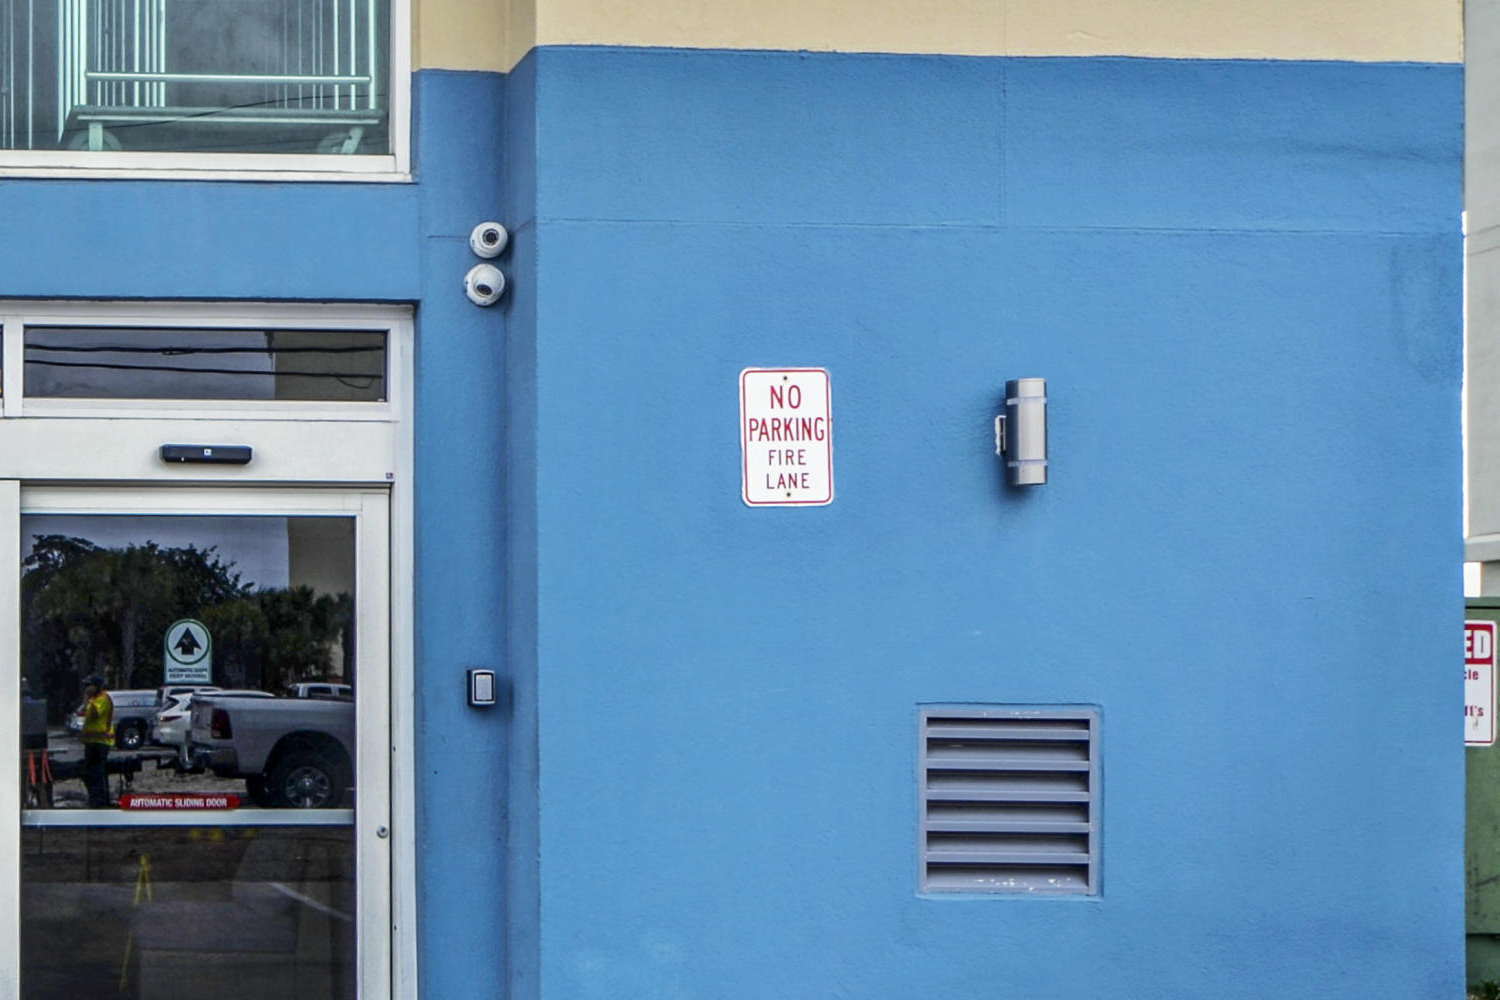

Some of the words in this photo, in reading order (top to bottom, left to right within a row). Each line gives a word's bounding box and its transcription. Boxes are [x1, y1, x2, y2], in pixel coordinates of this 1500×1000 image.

[770, 384, 801, 409] NO
[749, 417, 825, 442] PARKING
[768, 449, 807, 466] FIRE
[766, 472, 810, 490] LANE
[130, 798, 173, 808] AUTOMATIC
[174, 798, 204, 808] SLIDING
[205, 798, 227, 808] DOOR
